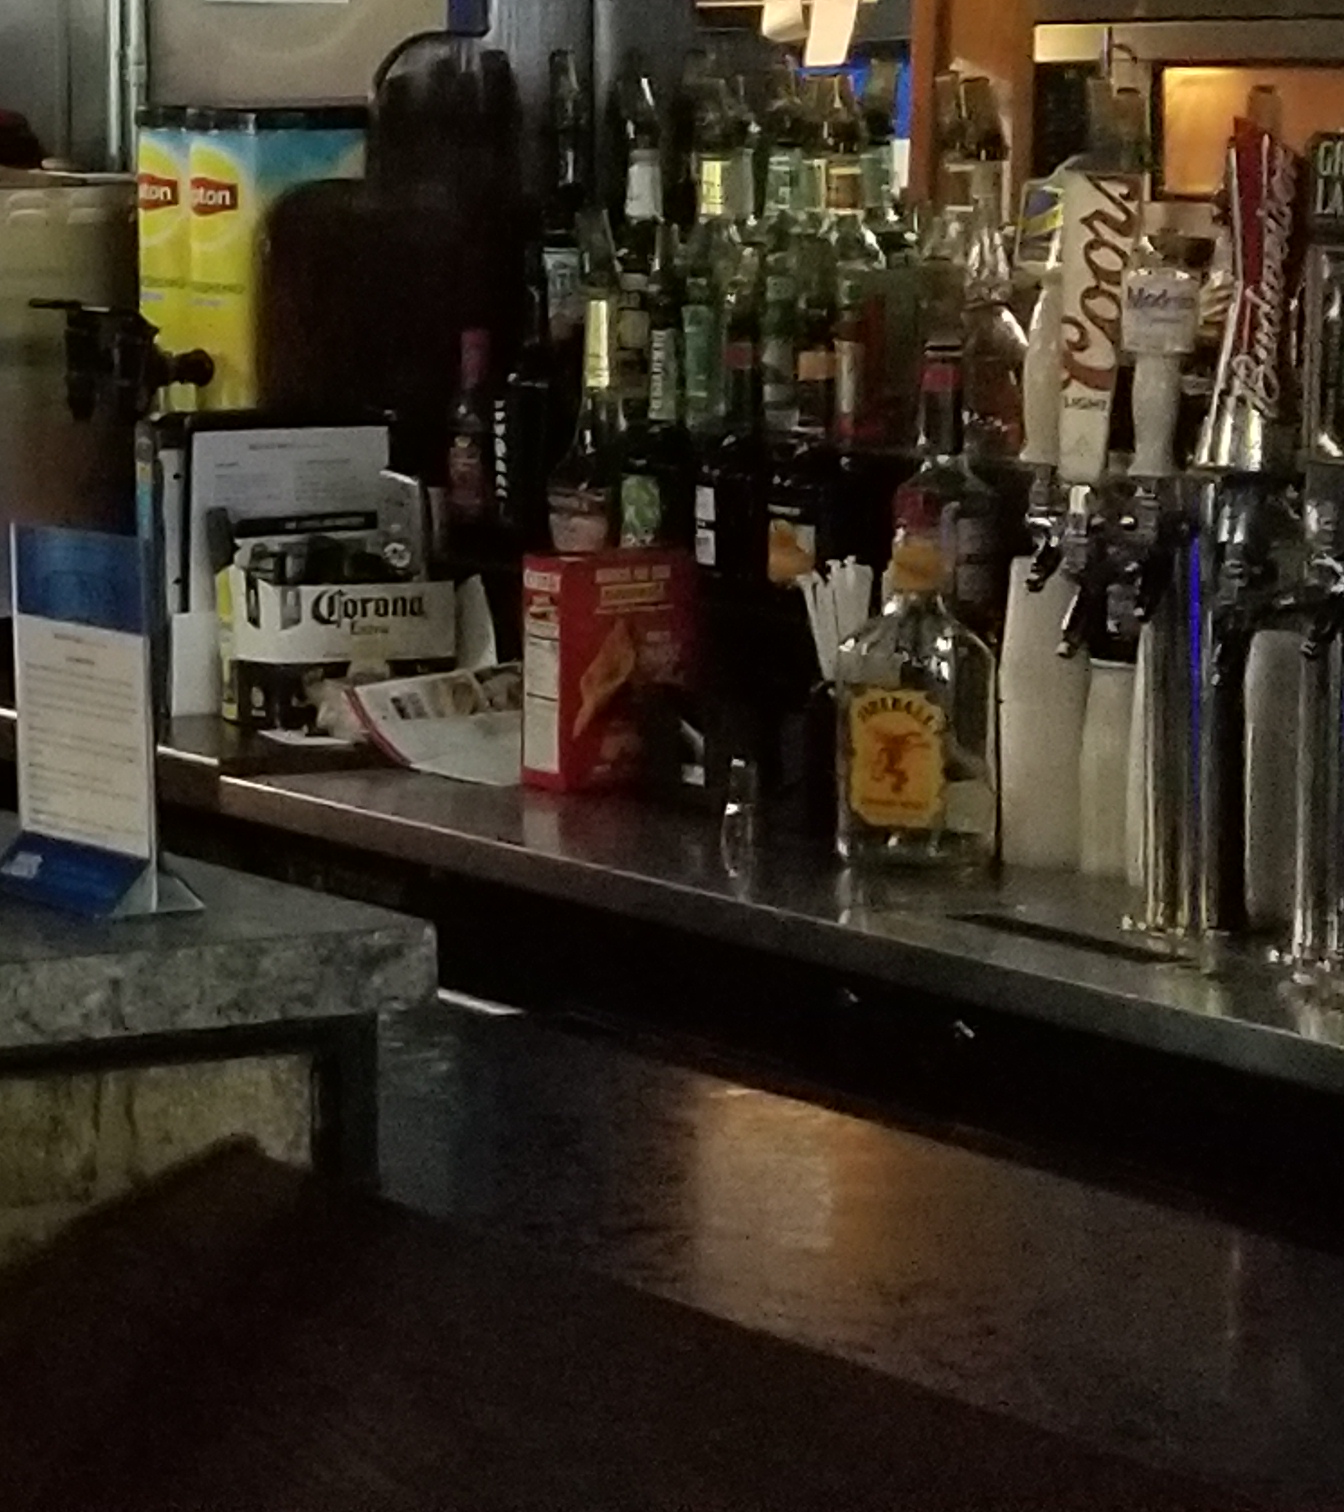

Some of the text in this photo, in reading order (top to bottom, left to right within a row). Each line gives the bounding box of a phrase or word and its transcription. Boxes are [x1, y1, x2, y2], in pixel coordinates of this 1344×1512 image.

[139, 184, 172, 201] ton
[1061, 172, 1144, 393] Coors
[311, 589, 428, 628] Corona
